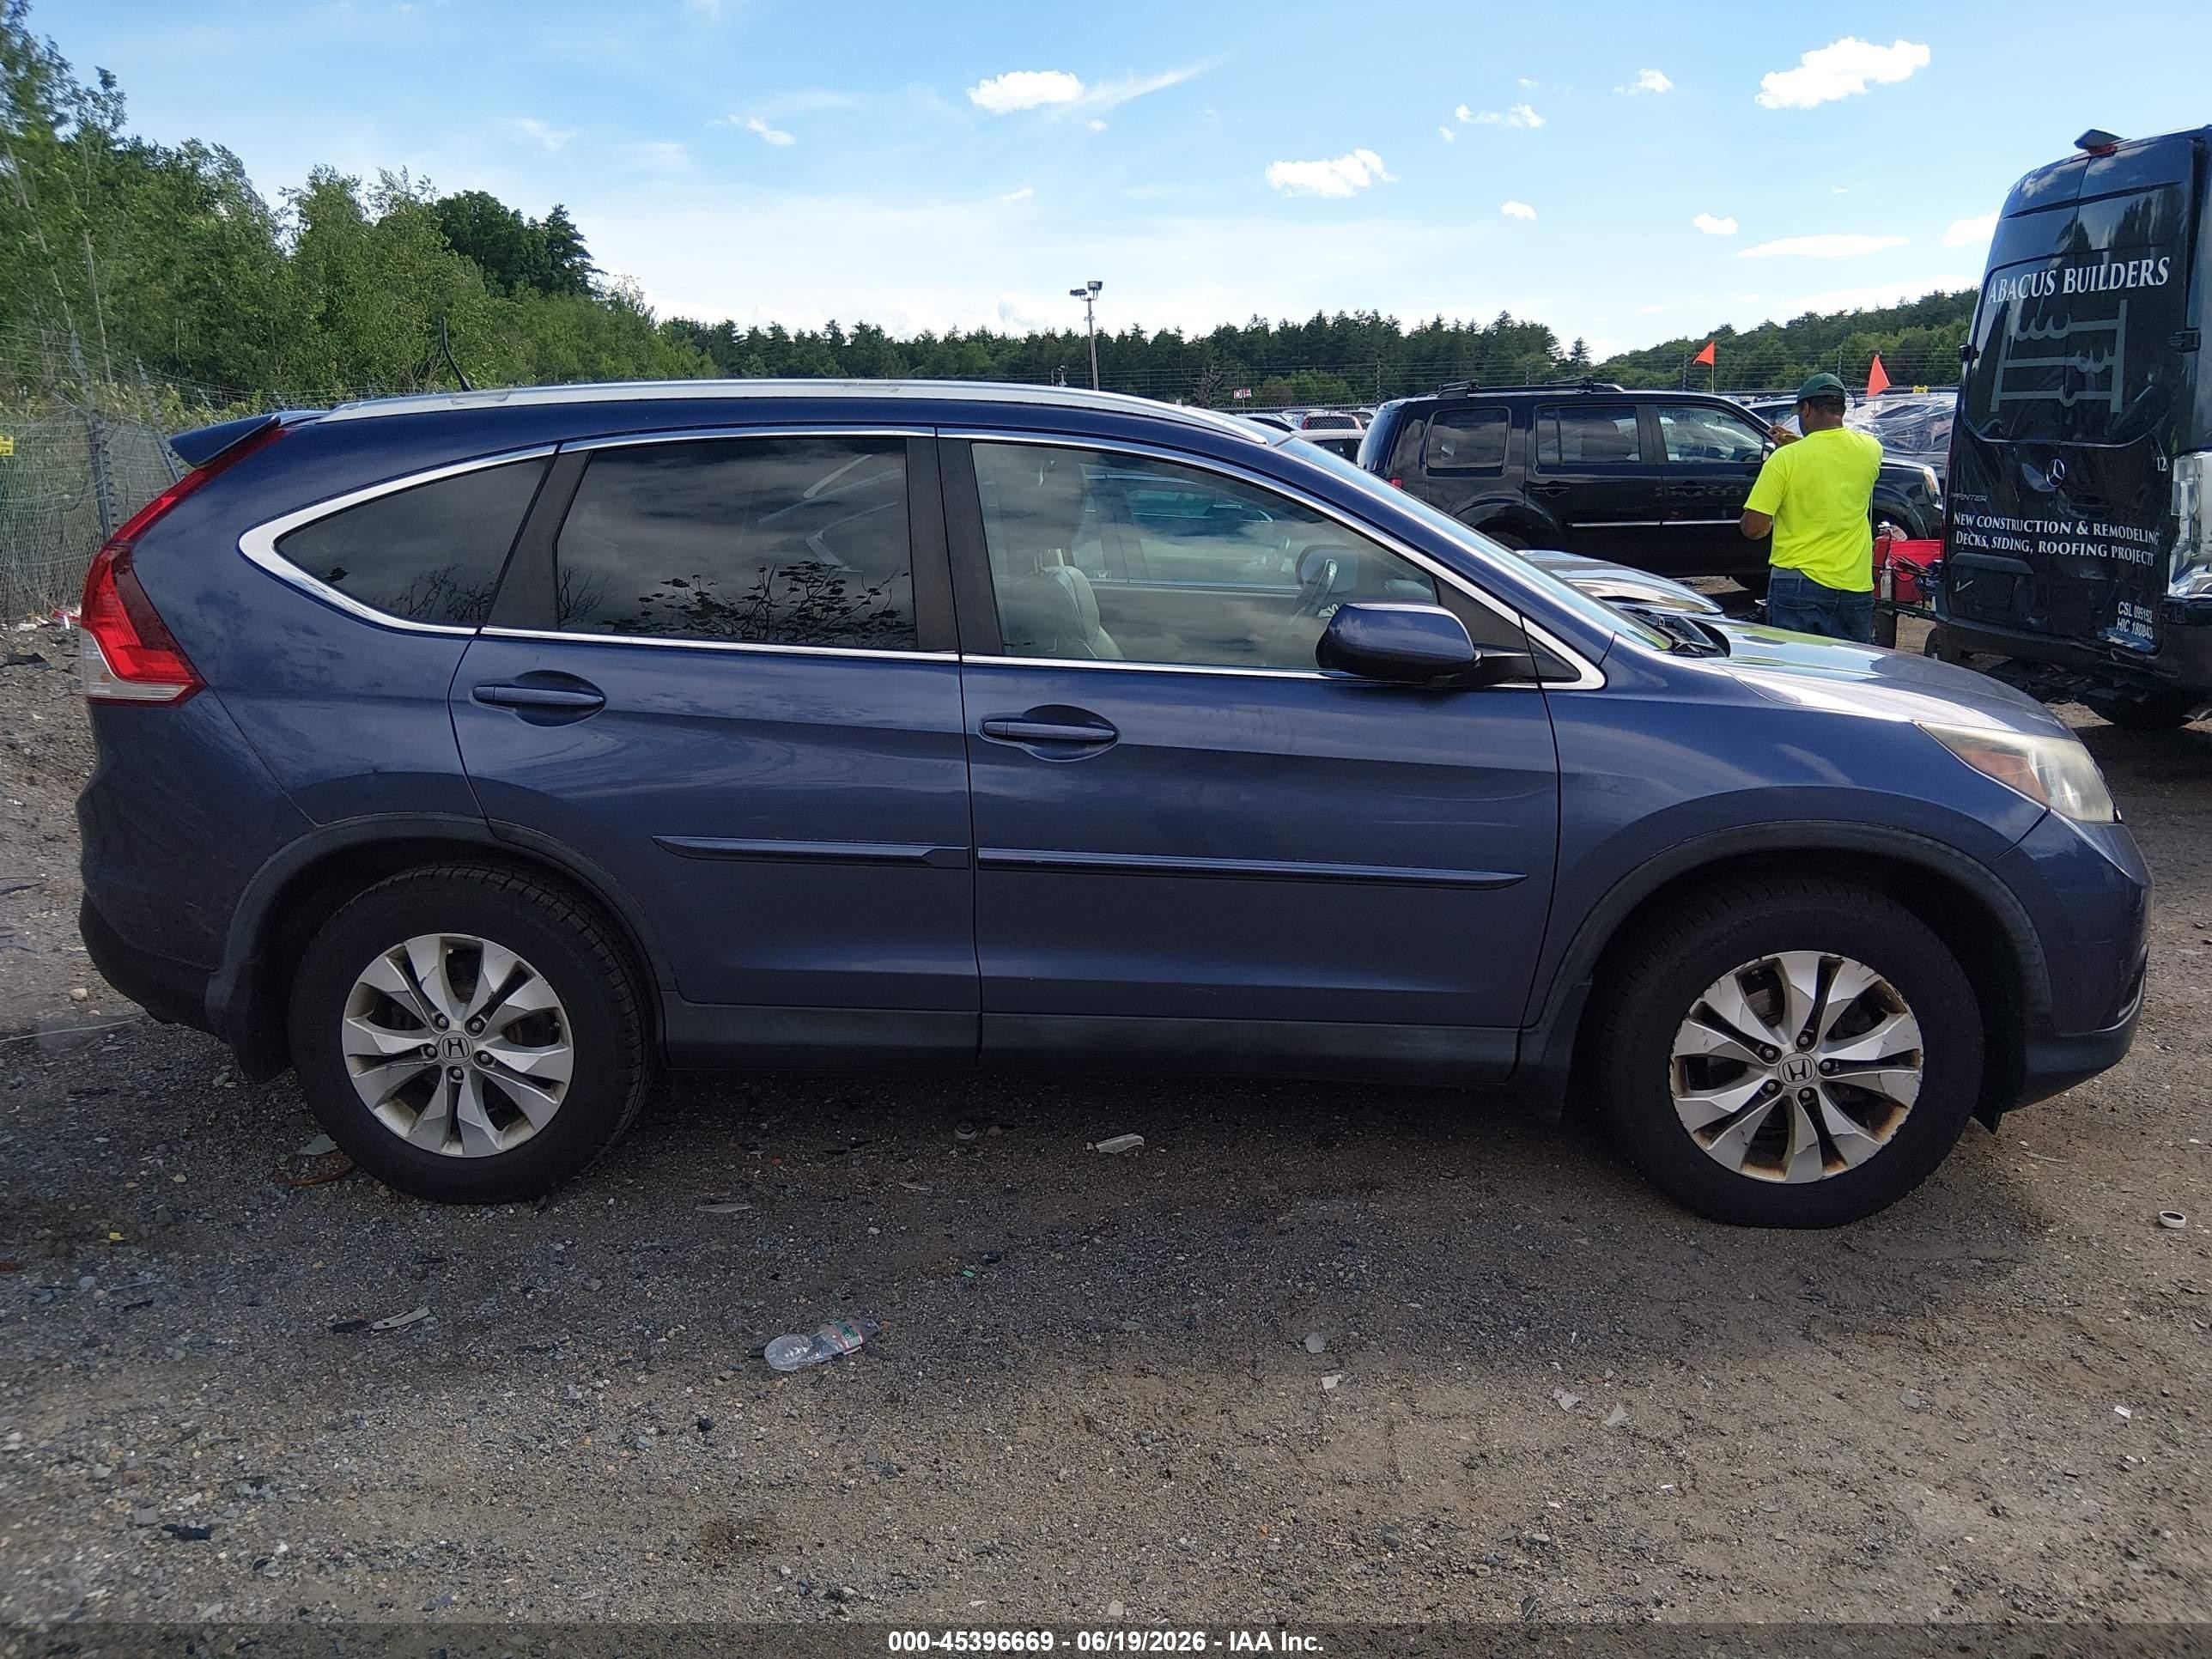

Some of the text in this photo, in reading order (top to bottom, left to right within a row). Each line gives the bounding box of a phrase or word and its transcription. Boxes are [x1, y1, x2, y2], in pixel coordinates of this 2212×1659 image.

[1987, 257, 2170, 304] ABACUS BUILDERS
[2157, 457, 2166, 471] 12
[1953, 512, 2160, 545] NEW CONSTRUCTION & REMODELING
[1956, 531, 2154, 567] DECKS, SIDING, ROOFING PROJECTS
[2118, 601, 2133, 617] CSL
[2116, 617, 2130, 632] HIC
